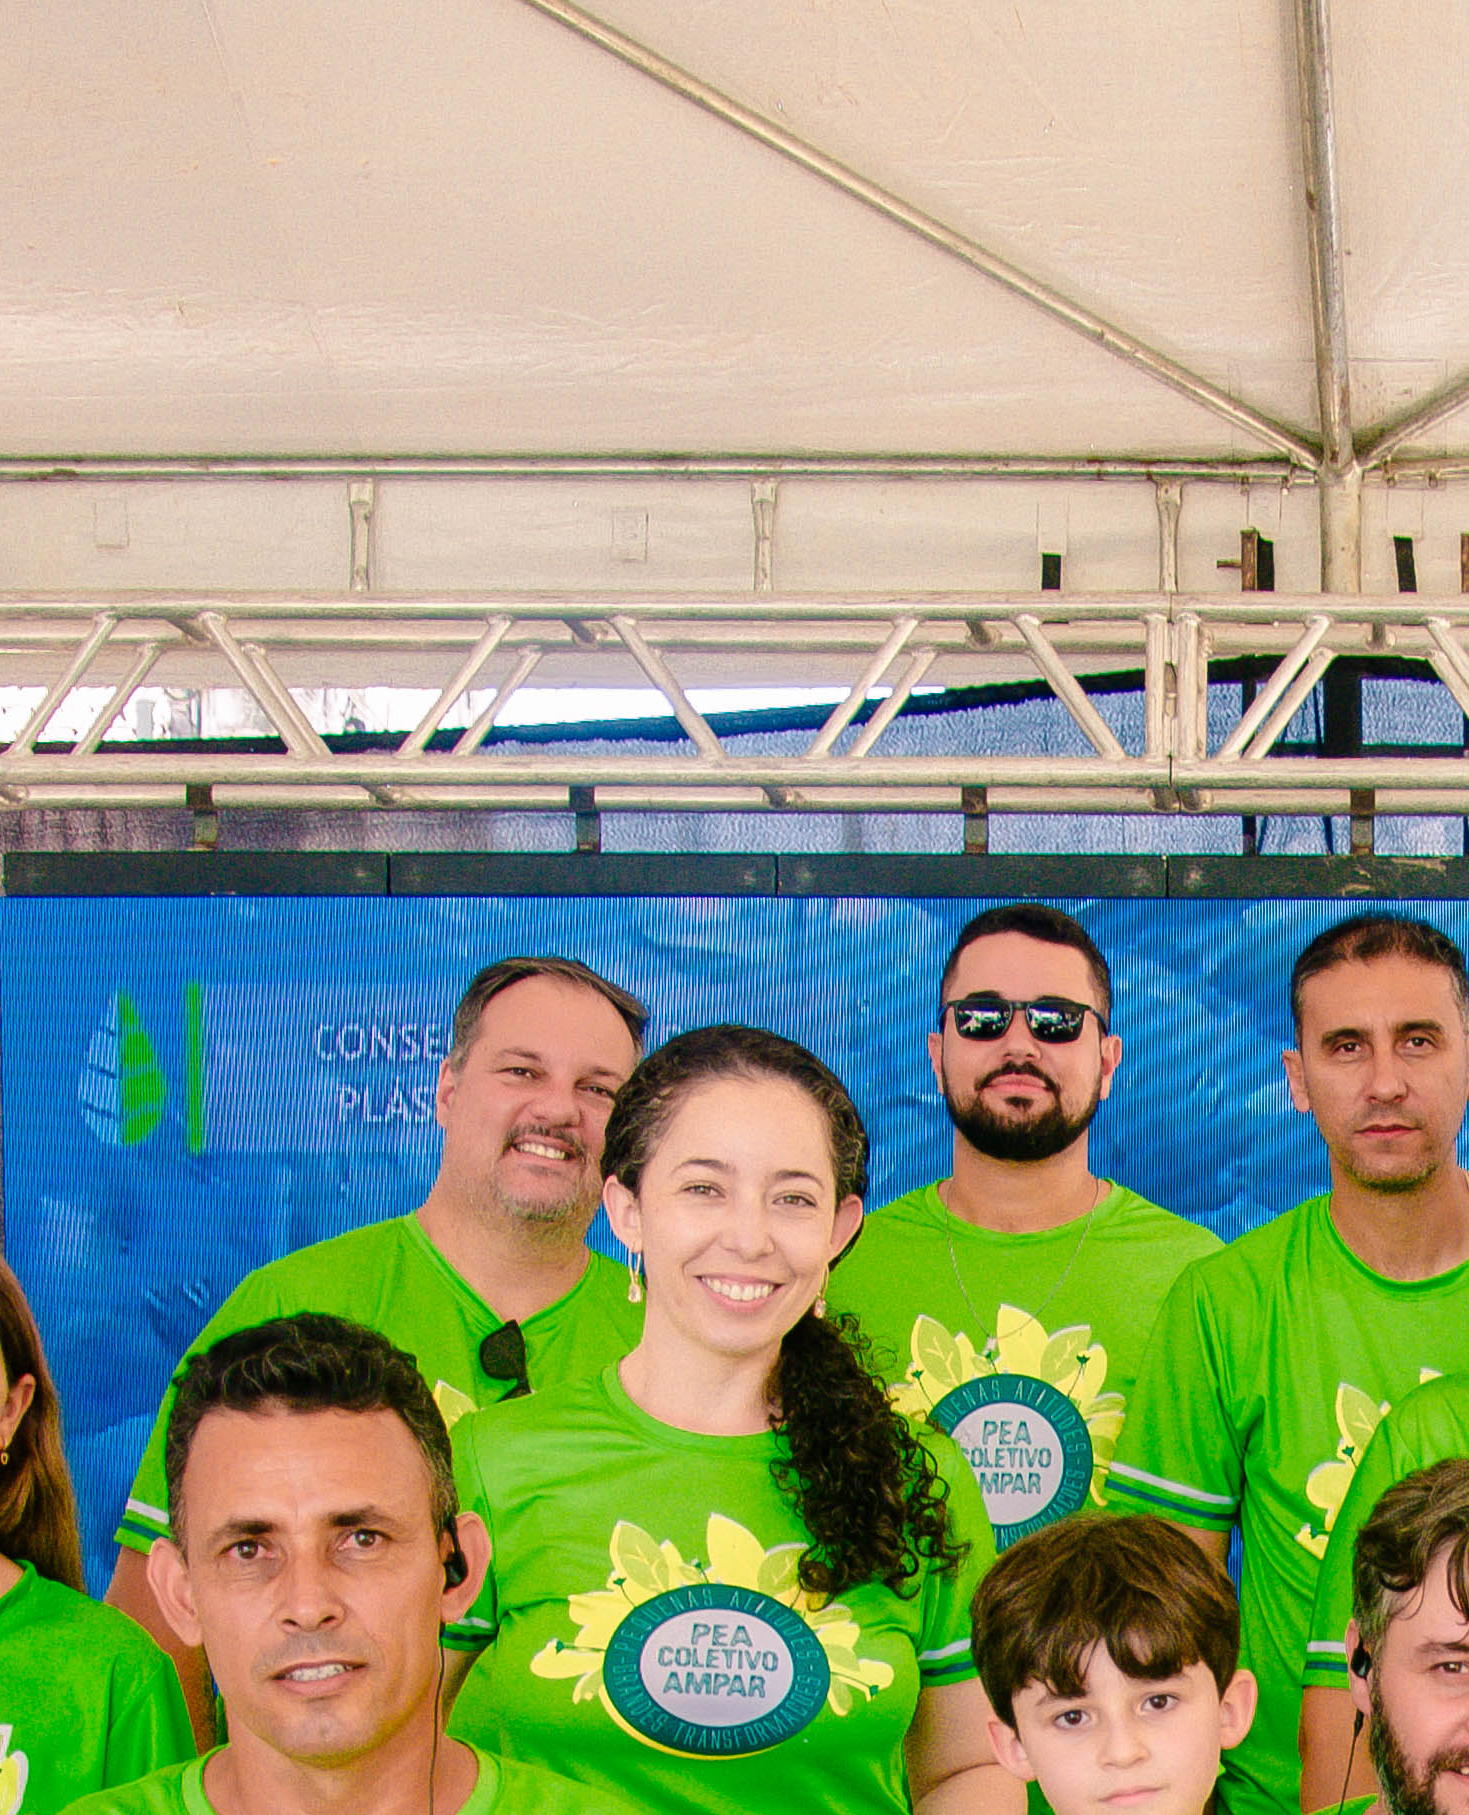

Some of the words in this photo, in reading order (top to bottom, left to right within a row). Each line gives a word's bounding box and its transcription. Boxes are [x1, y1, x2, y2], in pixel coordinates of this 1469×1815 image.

[315, 1024, 451, 1060] CONSE
[1015, 1380, 1087, 1451] ATITUDES
[982, 1420, 1032, 1445] PEA
[980, 1472, 1042, 1494] MPAR
[613, 1588, 713, 1654] PEQUENAS
[730, 1589, 820, 1663] ATITUDES
[691, 1623, 753, 1647] PEA
[657, 1646, 779, 1673] COLETIVO
[662, 1672, 766, 1698] AMPAR
